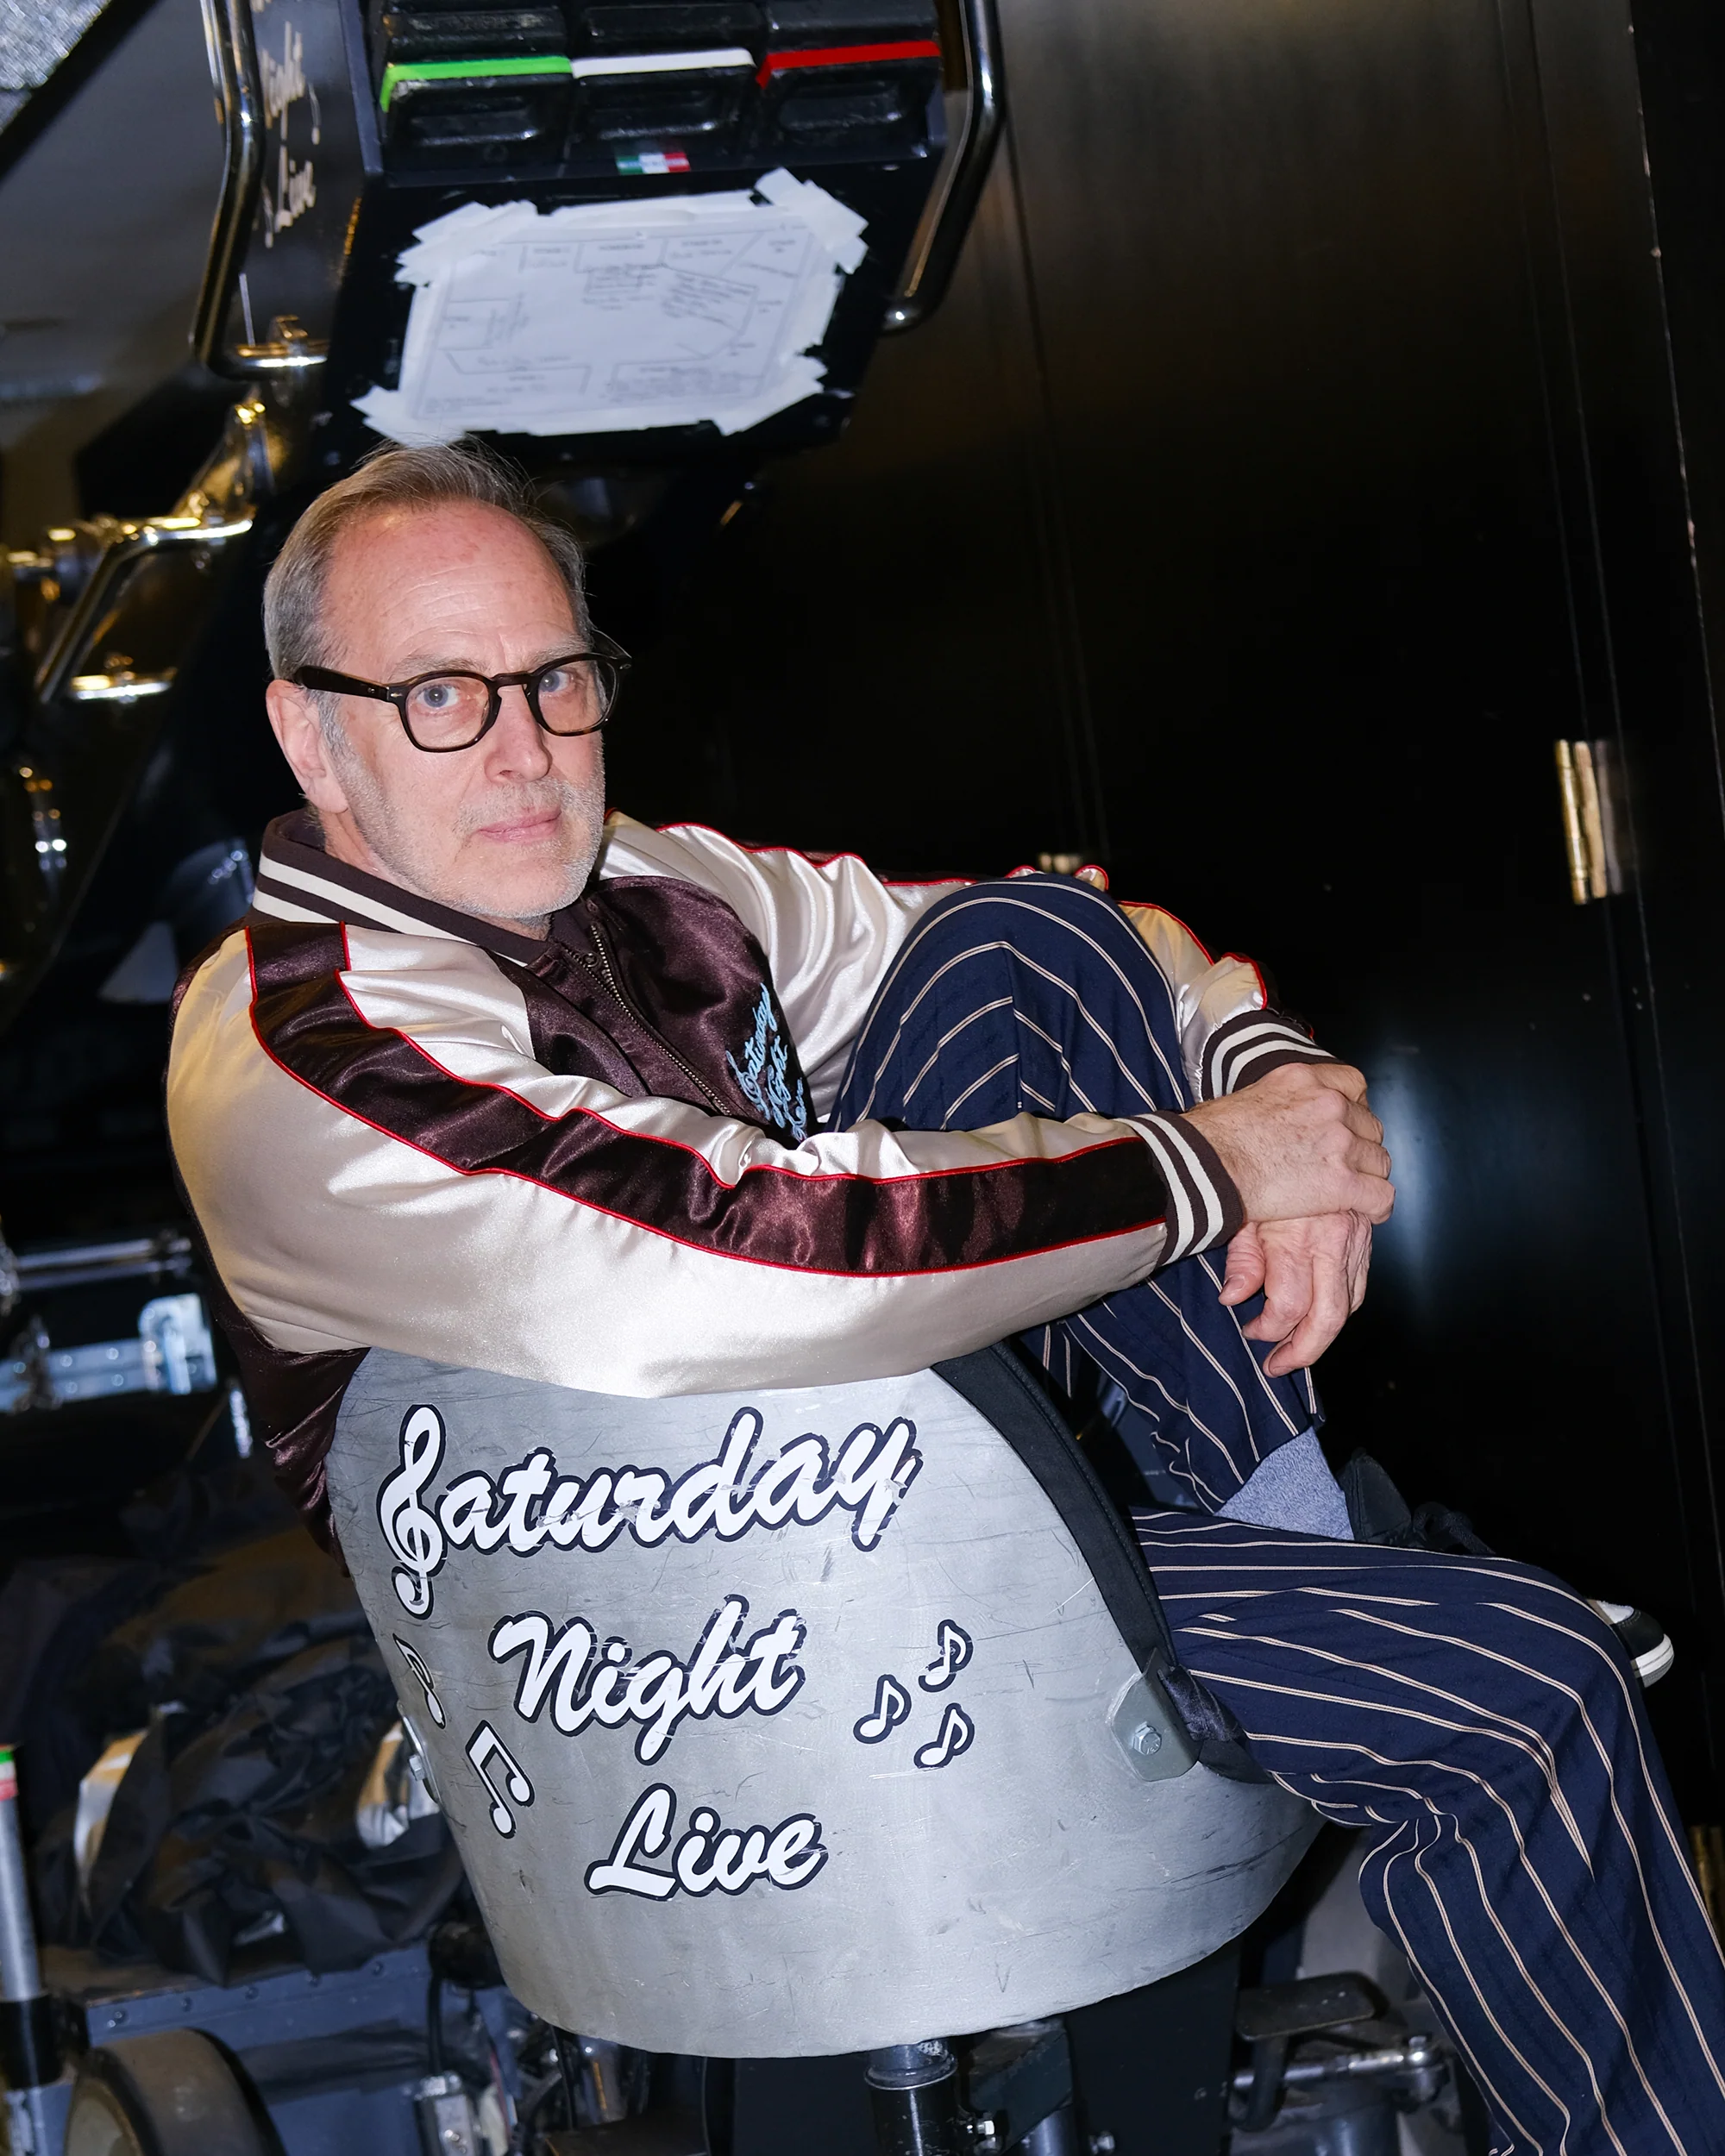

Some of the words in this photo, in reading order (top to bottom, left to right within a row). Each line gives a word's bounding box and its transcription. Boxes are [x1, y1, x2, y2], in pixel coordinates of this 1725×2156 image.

[725, 982, 778, 1120] Saturday
[765, 1035, 791, 1129] Night
[377, 1404, 924, 1616] Saturday
[487, 1595, 806, 1765] Night
[585, 1783, 829, 1902] Live
